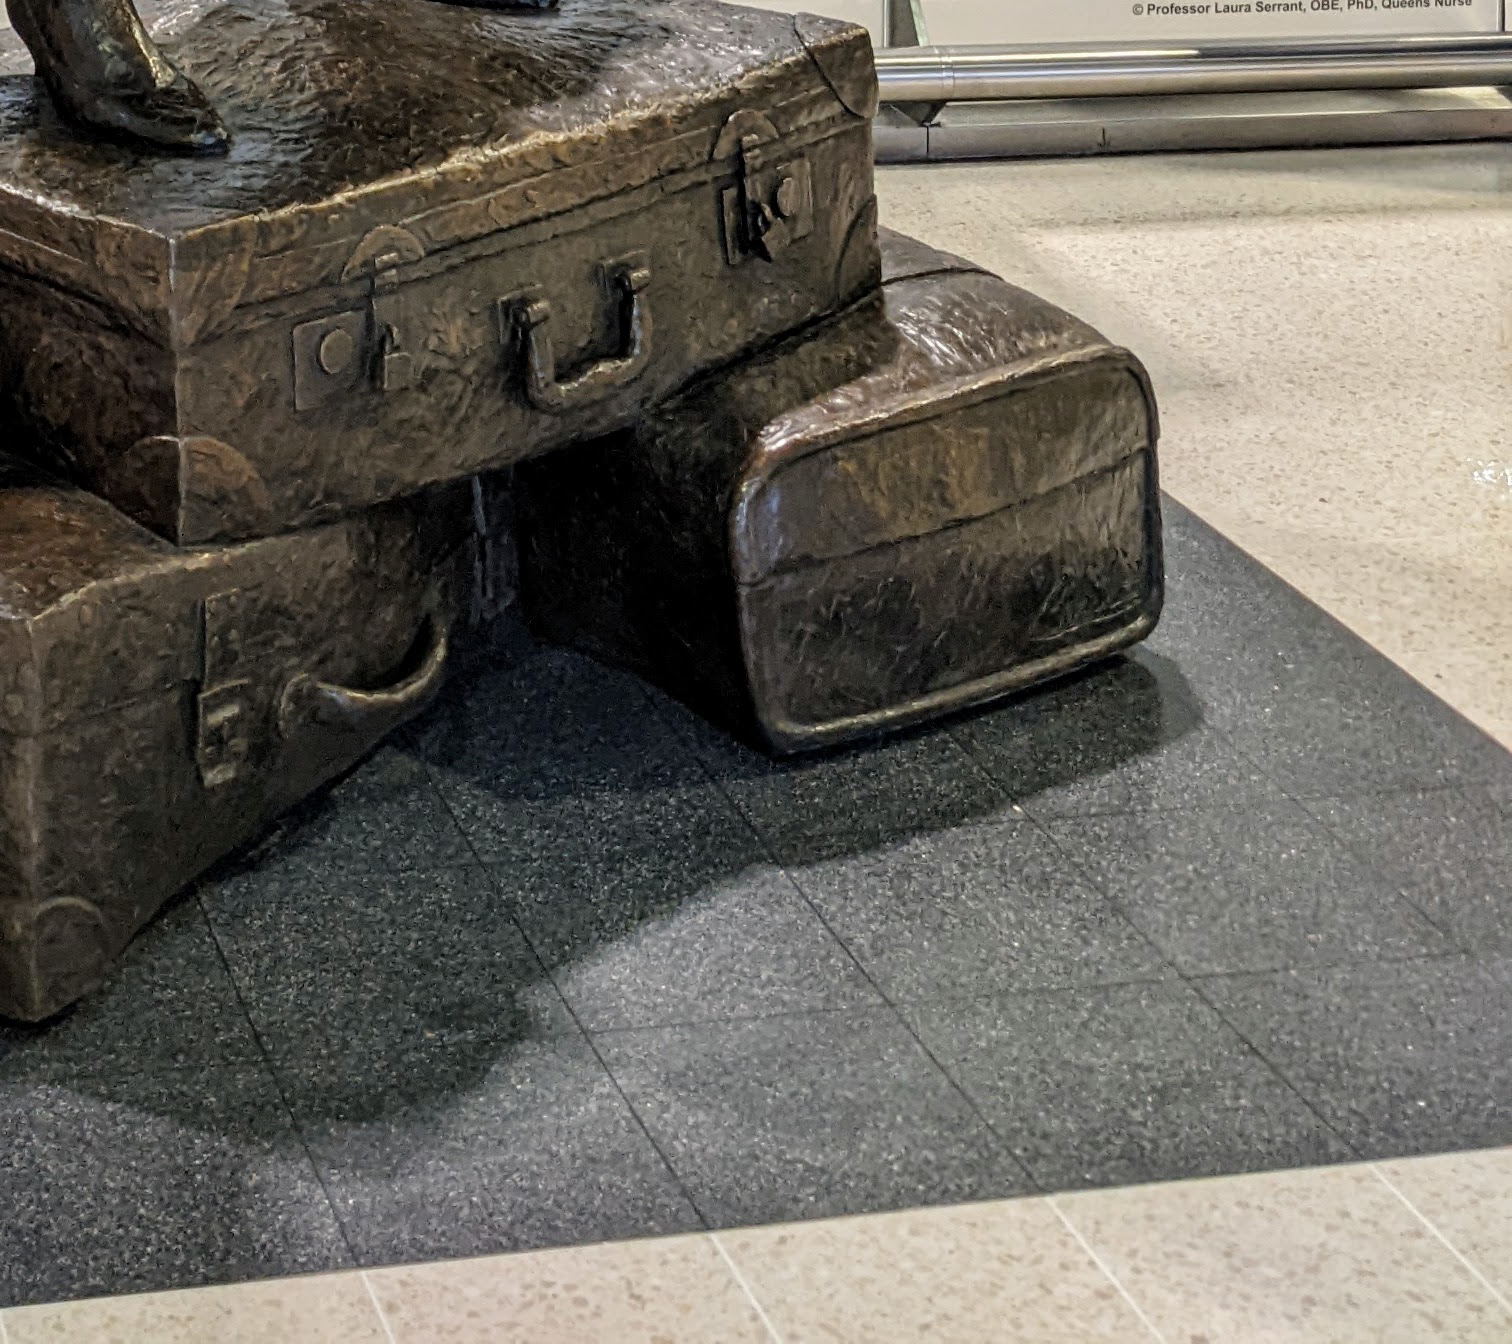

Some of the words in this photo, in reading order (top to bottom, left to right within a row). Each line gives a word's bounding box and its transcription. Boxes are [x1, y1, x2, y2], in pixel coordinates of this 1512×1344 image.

[1146, 2, 1211, 16] Professor
[1214, 1, 1251, 14] Laura
[1255, 0, 1306, 13] Serrant,
